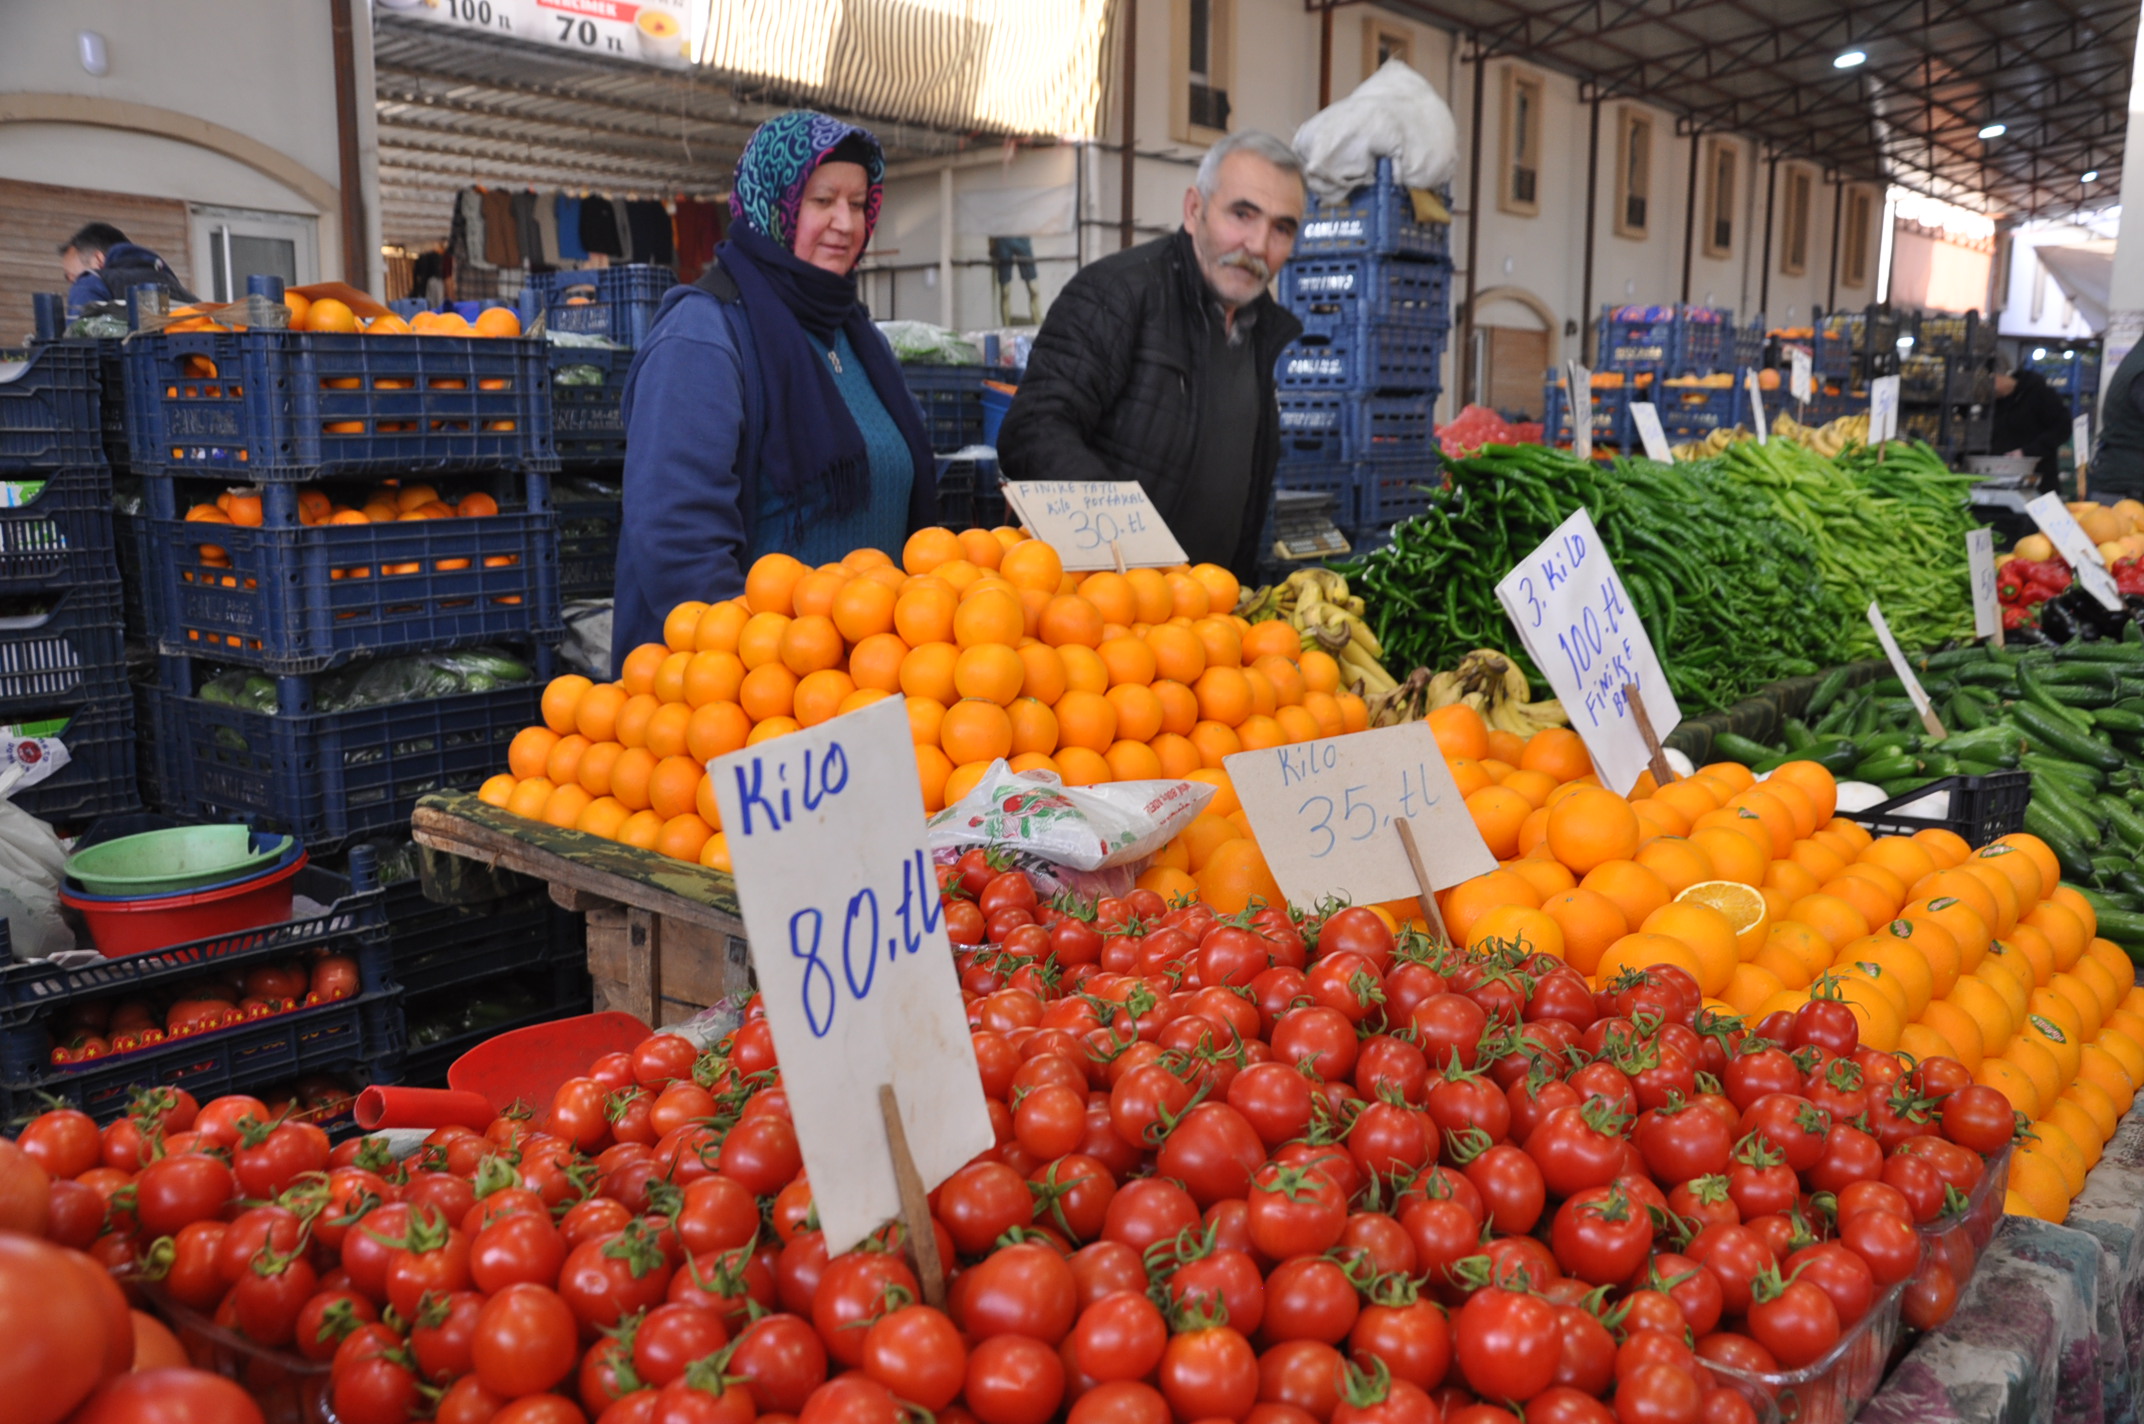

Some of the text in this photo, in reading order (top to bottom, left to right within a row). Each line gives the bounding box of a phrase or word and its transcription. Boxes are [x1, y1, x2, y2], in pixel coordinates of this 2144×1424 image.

[449, 0, 512, 30] 100 TL
[556, 15, 623, 51] 70 TL
